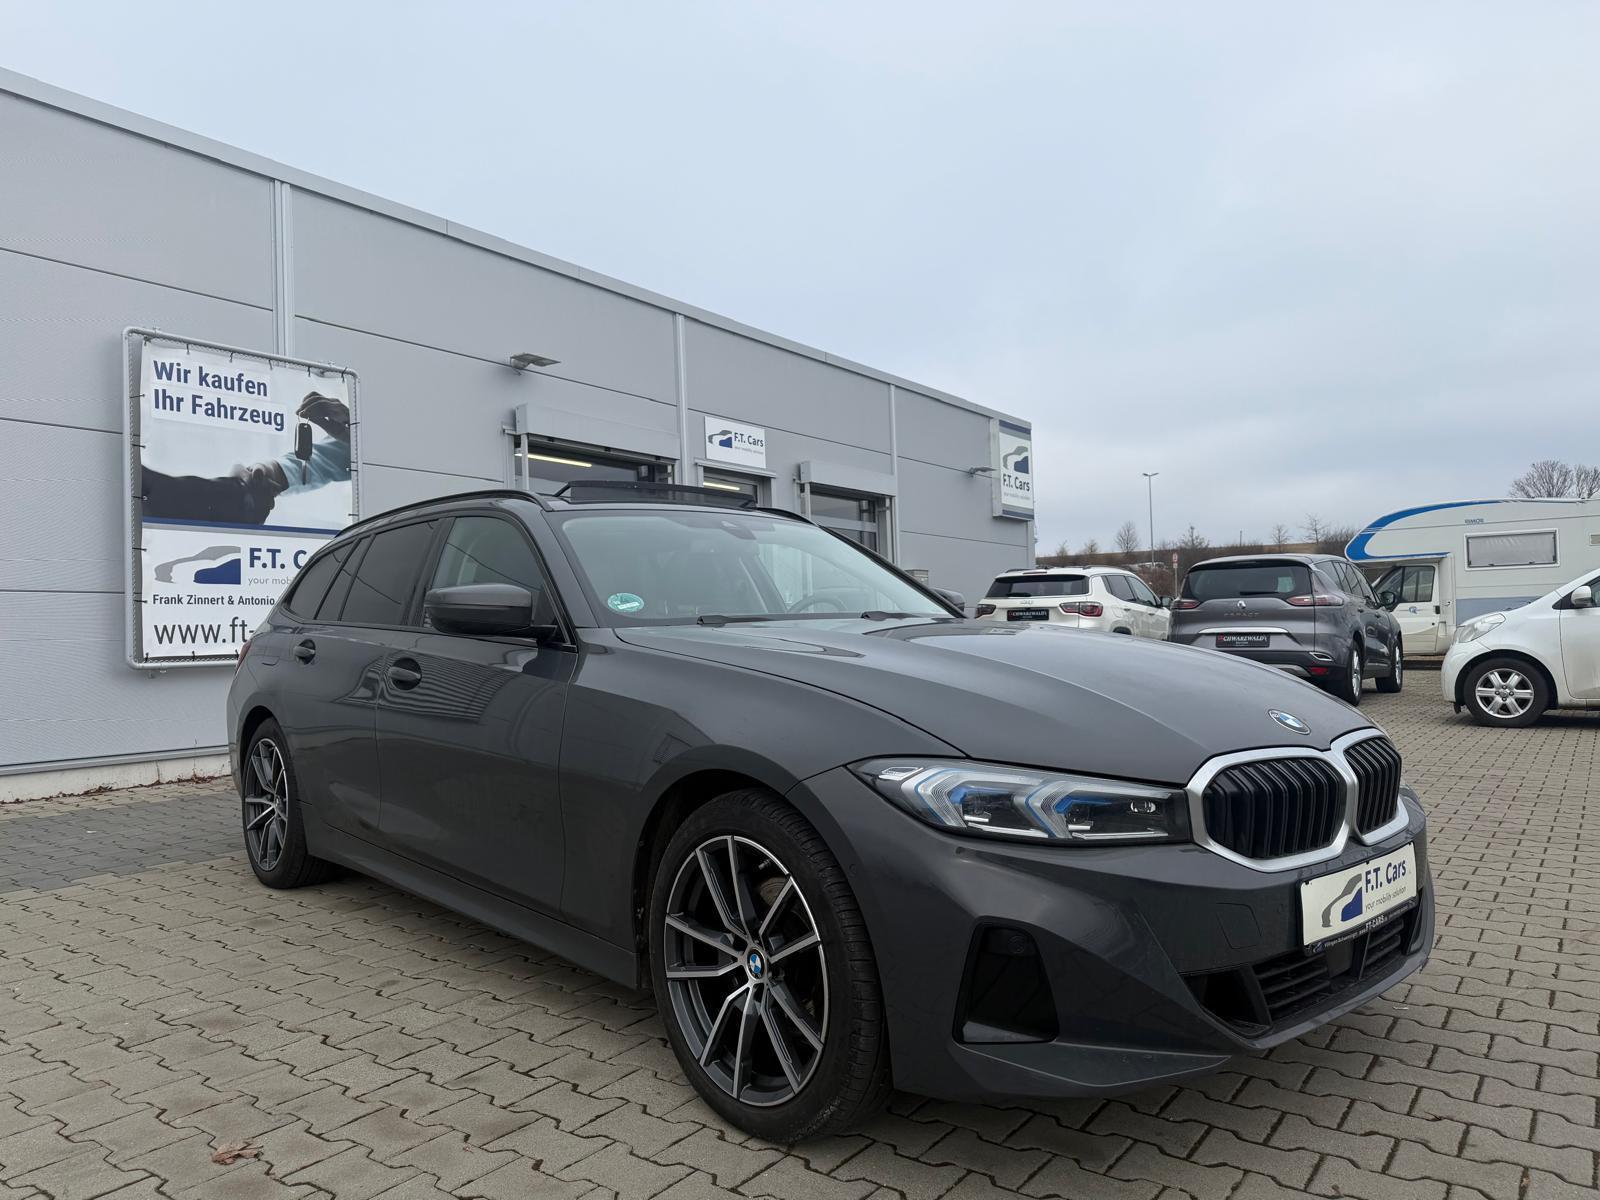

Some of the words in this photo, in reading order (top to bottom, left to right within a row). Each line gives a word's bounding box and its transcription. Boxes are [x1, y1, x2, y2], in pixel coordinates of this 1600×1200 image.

[153, 360, 191, 384] Wir
[198, 366, 268, 396] kaufen
[153, 388, 184, 412] Ihr
[191, 394, 285, 431] Fahrzeug
[734, 432, 746, 444] F.T.
[747, 435, 764, 447] Cars
[1002, 473, 1013, 488] F.T.
[1014, 476, 1030, 492] Cars
[249, 547, 286, 569] F.T.
[248, 577, 270, 586] your
[153, 594, 183, 605] Frank
[187, 594, 225, 605] Zinnert
[227, 595, 234, 605] &
[237, 595, 275, 606] Antonio
[1365, 867, 1383, 893] F.T.
[1385, 860, 1407, 885] Cars
